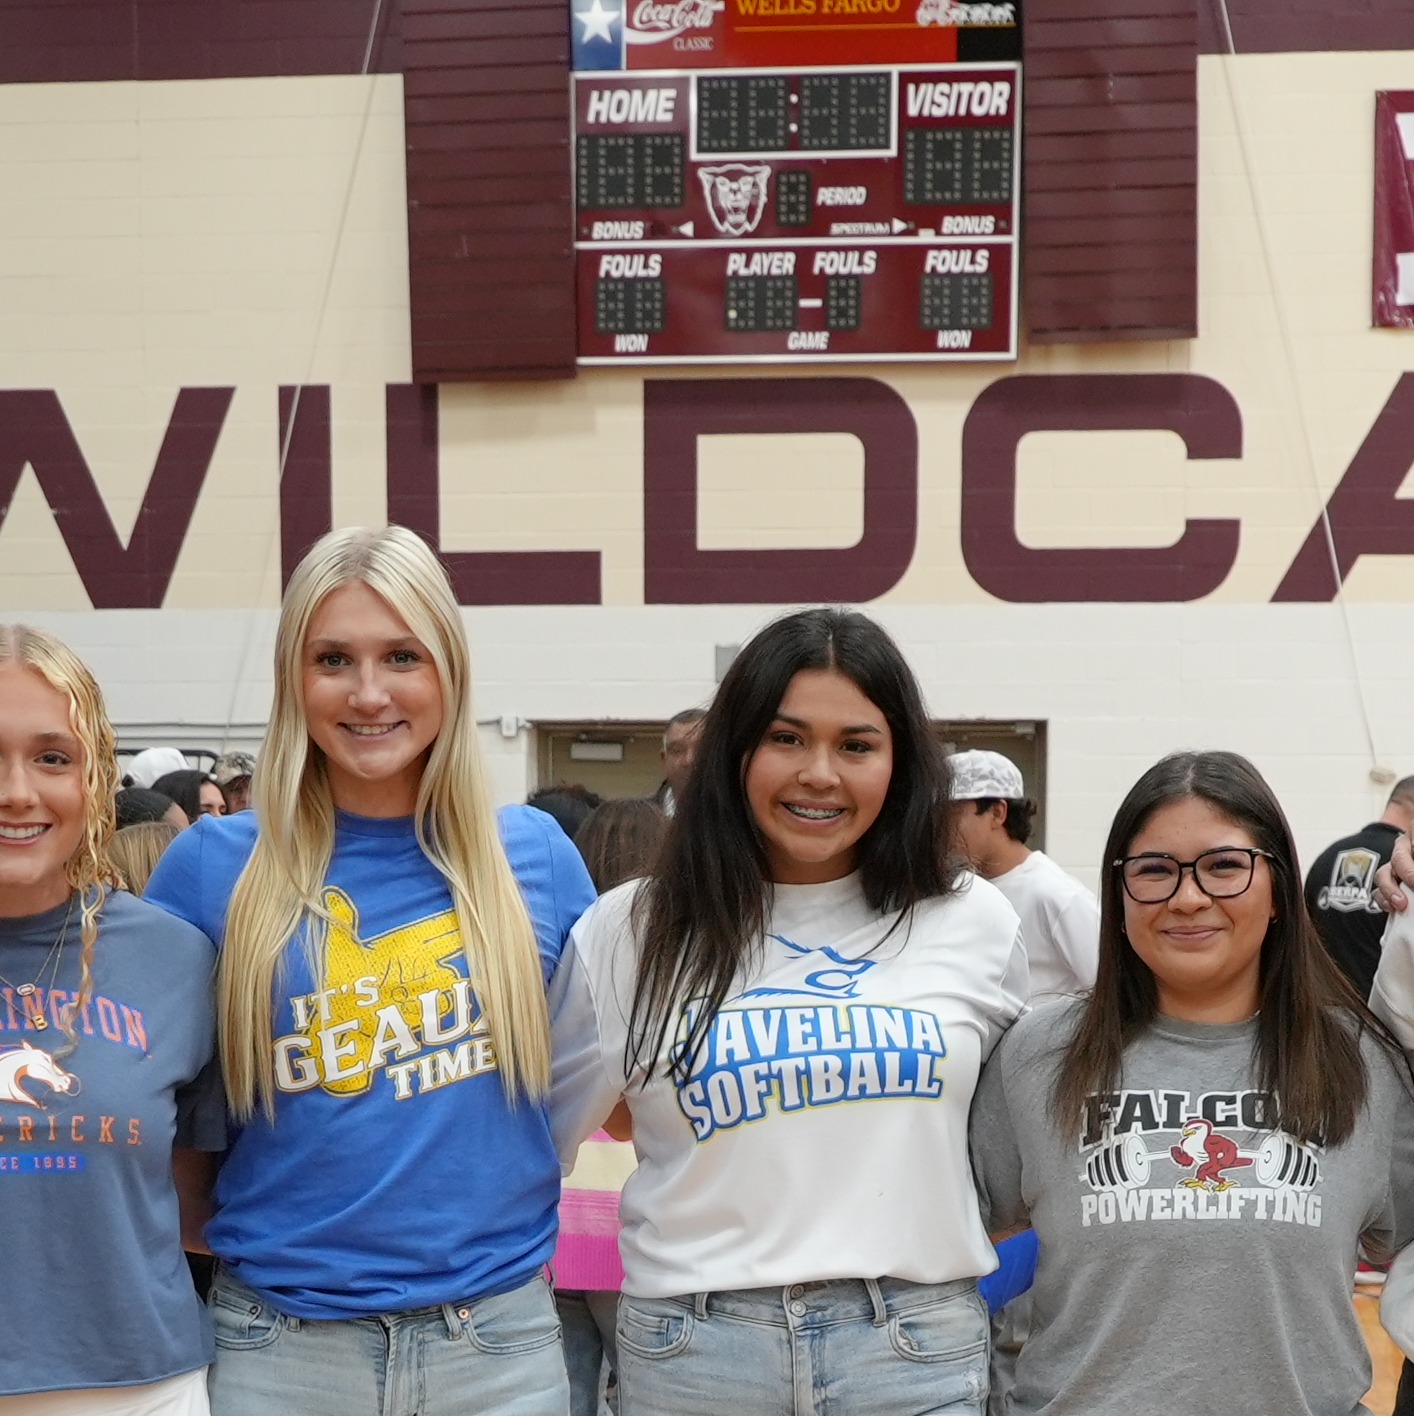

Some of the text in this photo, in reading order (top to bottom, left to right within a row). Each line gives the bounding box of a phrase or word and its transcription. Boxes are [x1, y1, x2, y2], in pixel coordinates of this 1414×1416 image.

[737, 0, 901, 15] WELLS FARGO
[673, 36, 715, 51] CLASSIC
[588, 89, 678, 124] HOME
[906, 82, 1011, 118] VISITOR
[816, 186, 867, 206] PERIOD
[592, 220, 645, 240] BONUS
[941, 215, 996, 234] BONUS
[599, 254, 663, 279] FOULS
[726, 250, 878, 276] PLAYER FOULS
[924, 248, 990, 274] FOULS
[614, 333, 649, 353] WON
[787, 331, 830, 350] GAME
[937, 329, 973, 349] WON
[272, 980, 489, 1093] GEAU
[385, 1037, 498, 1101] TIME
[676, 1050, 945, 1143] SOFTBALL
[1078, 1088, 1327, 1155] FALCO
[1080, 1187, 1323, 1228] POWERLIFTING
